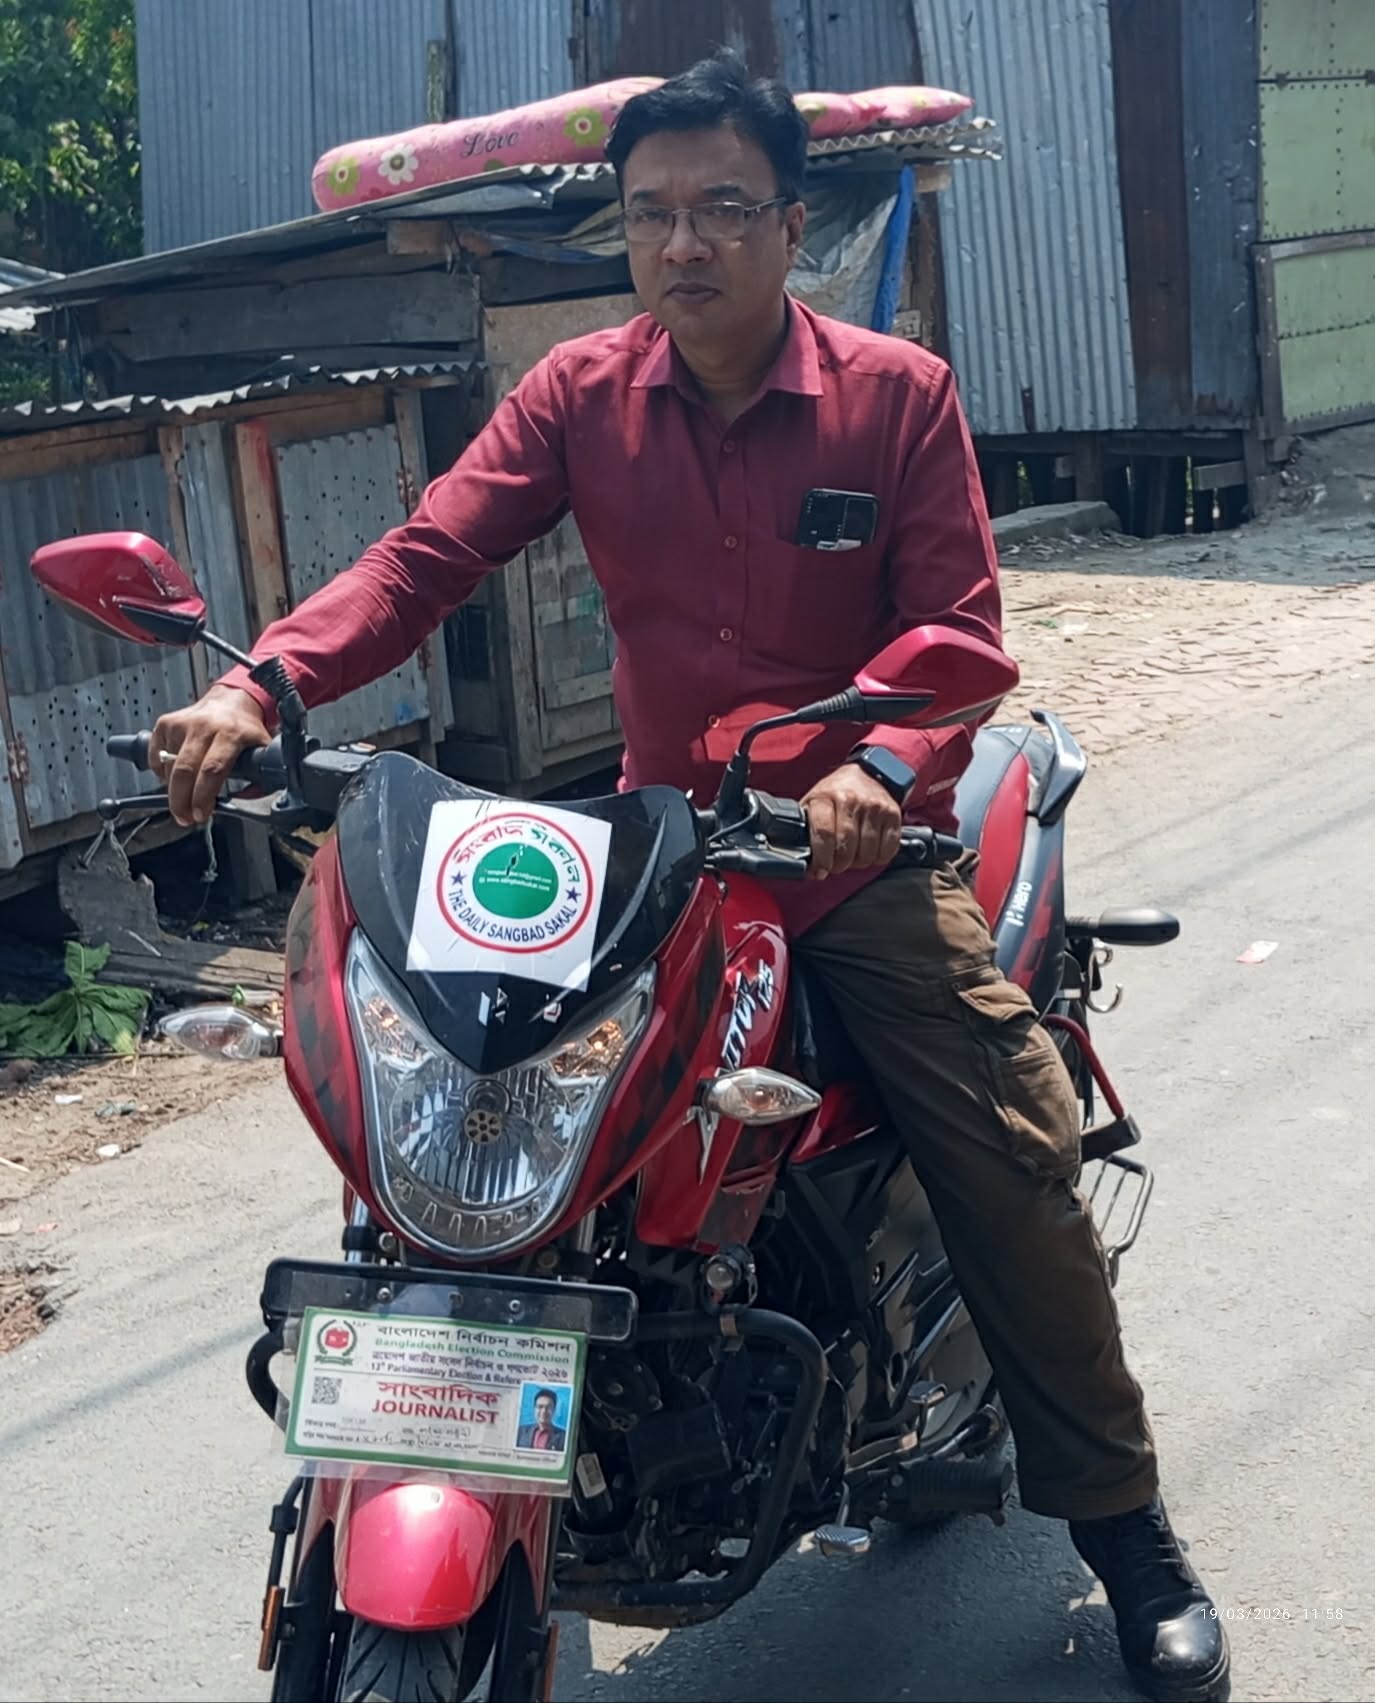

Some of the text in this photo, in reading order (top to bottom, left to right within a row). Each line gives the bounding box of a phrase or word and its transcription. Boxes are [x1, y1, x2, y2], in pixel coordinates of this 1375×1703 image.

[459, 131, 519, 159] Love
[448, 888, 578, 942] THE DAILY SANGBAD SAKAL
[374, 1338, 571, 1365] Bangladesh Election Commission
[377, 1324, 571, 1352] বাংলাদেশ নির্বাচন কমিশন
[376, 1380, 502, 1407] সাংবাদিক
[371, 1398, 500, 1425] JOURNALIST
